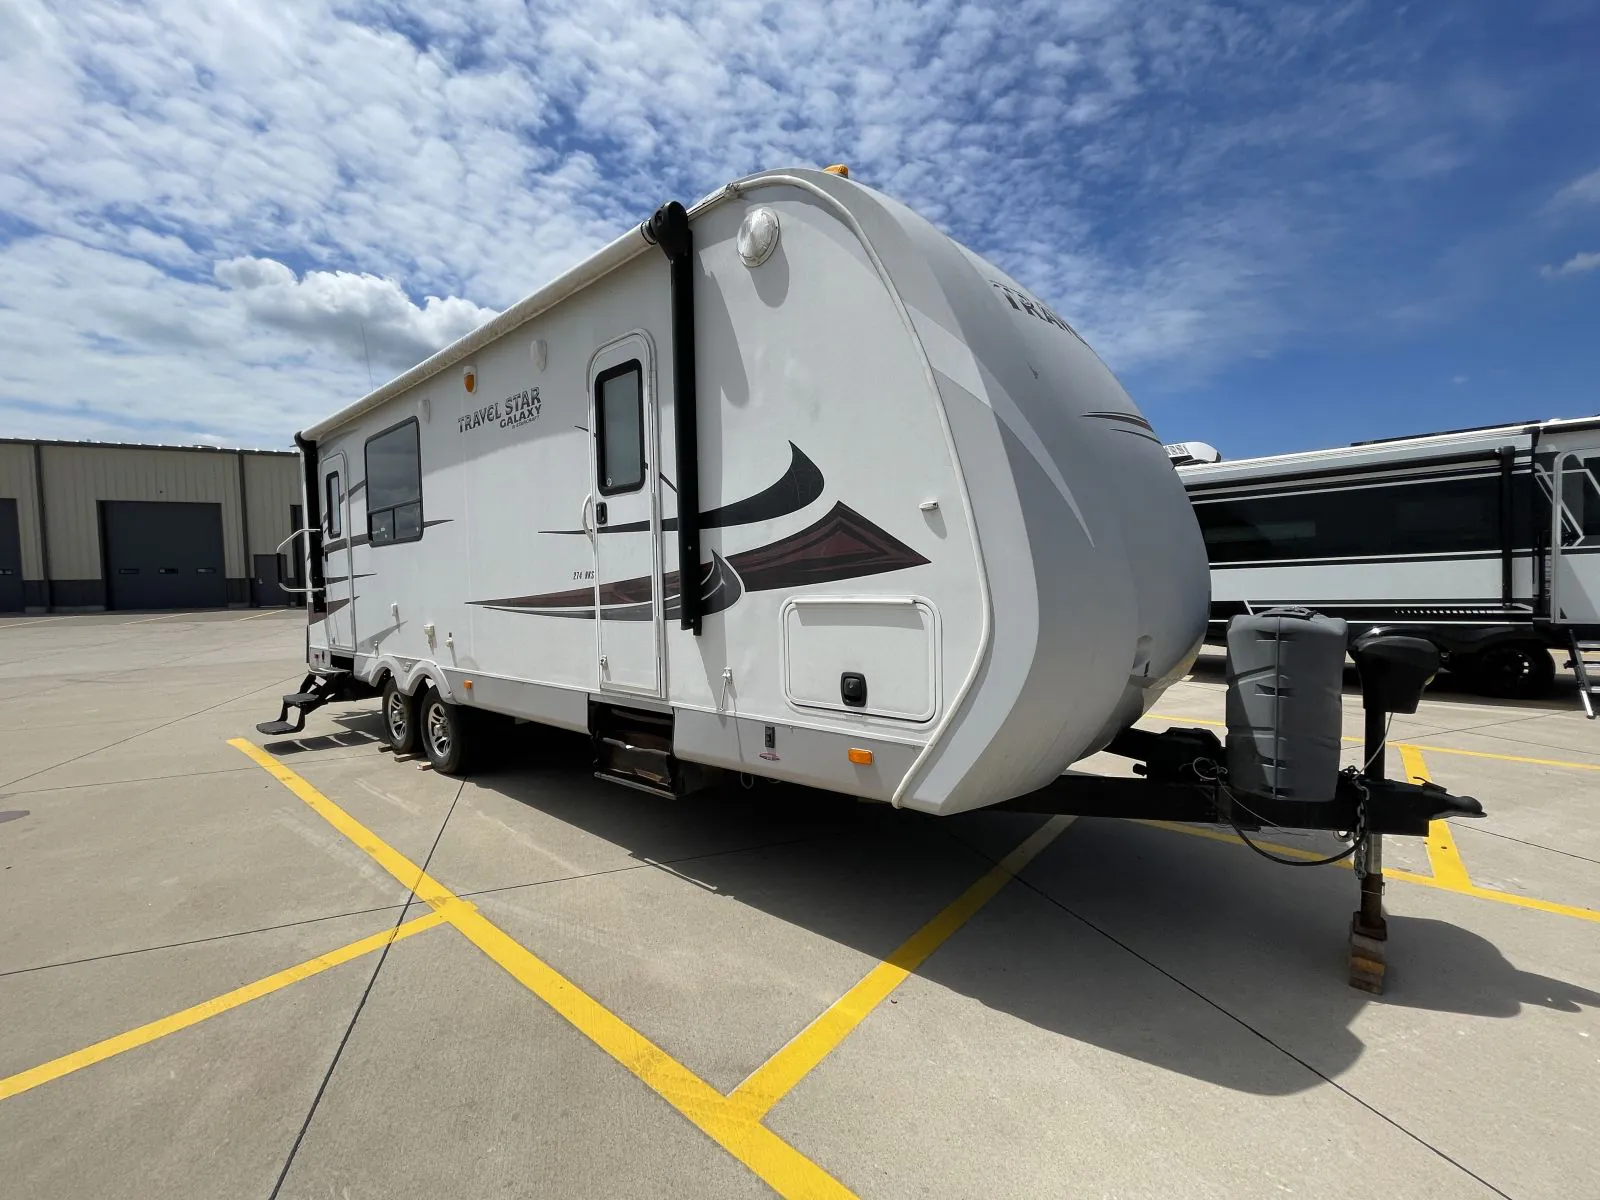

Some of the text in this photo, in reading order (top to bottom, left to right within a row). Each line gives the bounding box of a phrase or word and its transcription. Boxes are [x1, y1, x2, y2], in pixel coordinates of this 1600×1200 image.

[458, 386, 541, 433] TRAVEL STAR
[500, 404, 541, 428] GALAXY
